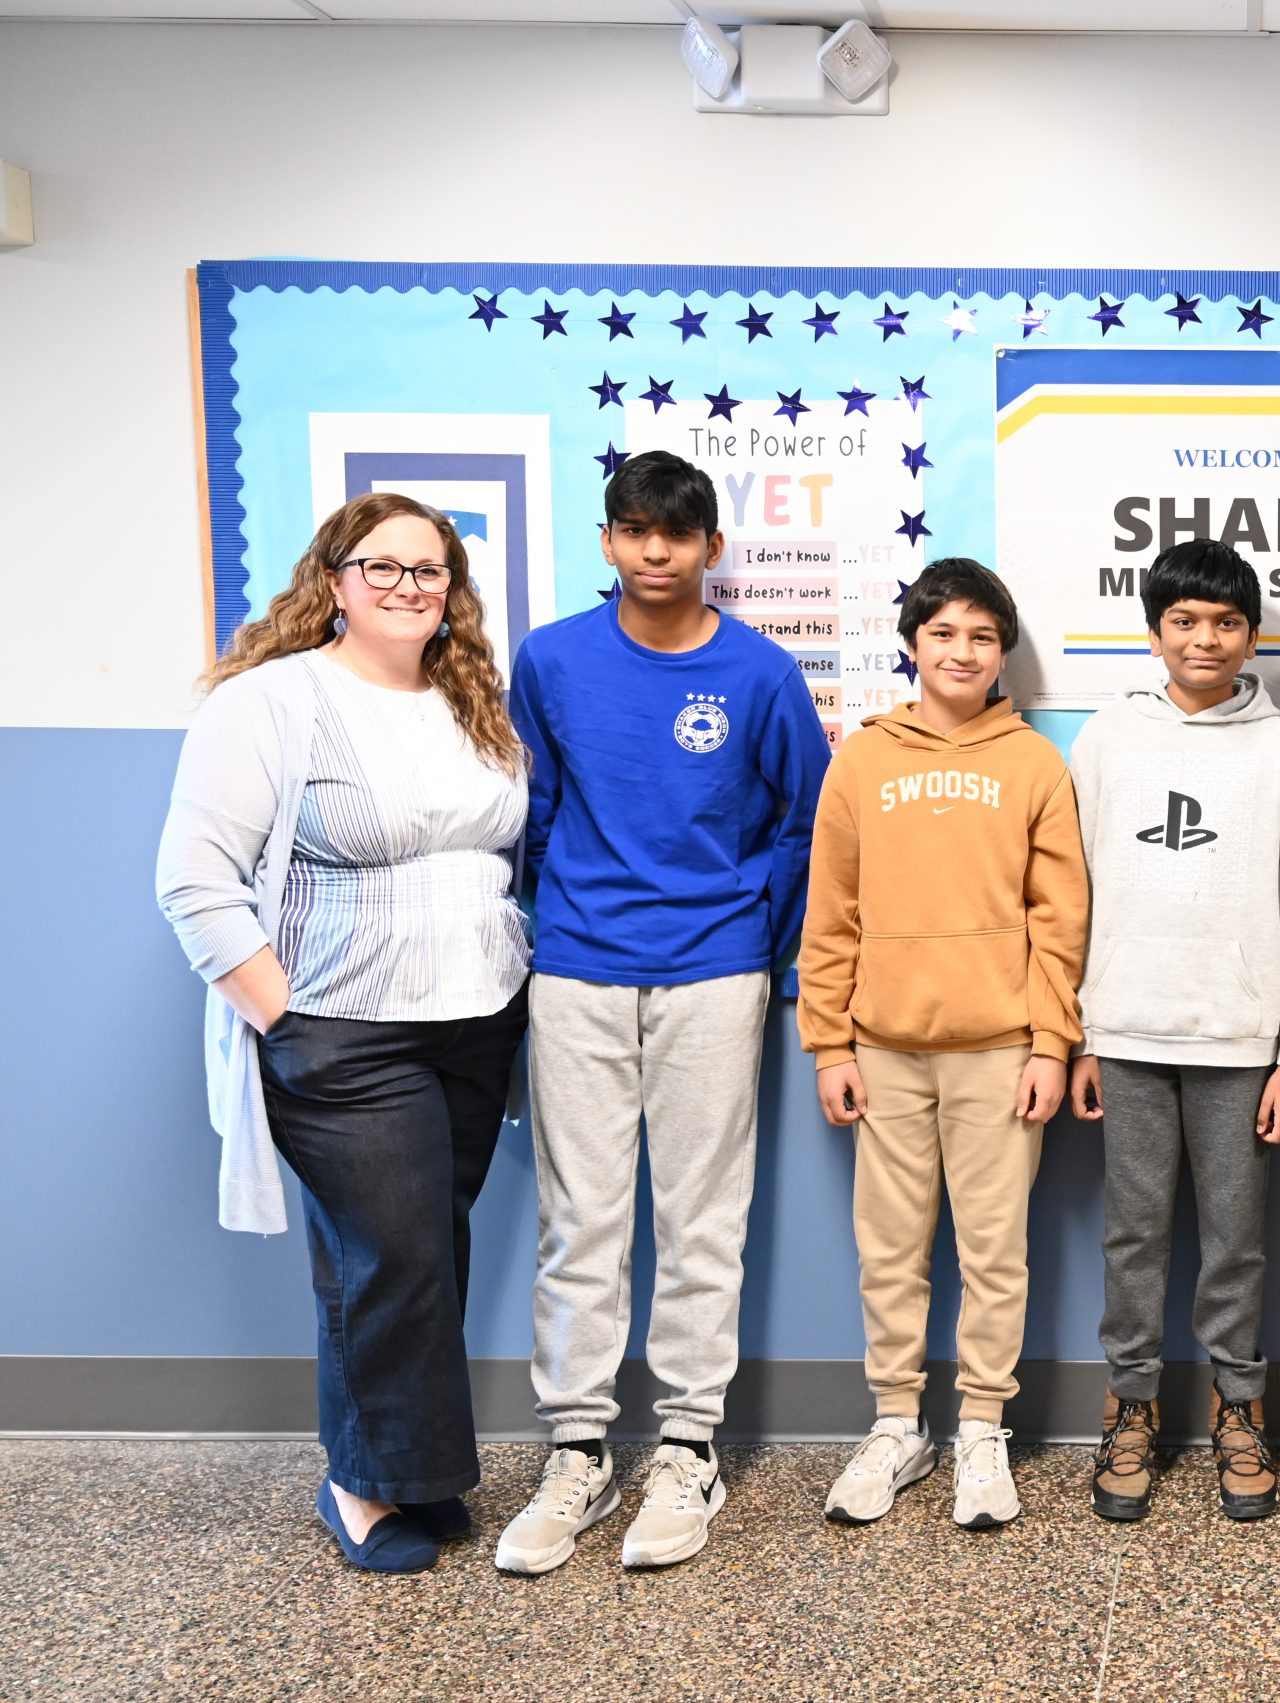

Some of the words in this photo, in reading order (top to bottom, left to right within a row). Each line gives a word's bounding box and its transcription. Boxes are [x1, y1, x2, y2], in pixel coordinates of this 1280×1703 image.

[689, 428, 736, 456] The
[750, 428, 826, 457] Power
[839, 428, 867, 456] of
[724, 471, 834, 527] YET
[746, 549, 752, 563] I
[757, 549, 792, 563] don't
[797, 548, 831, 563] know
[712, 585, 740, 599] This
[744, 585, 794, 599] doesn't
[799, 586, 832, 599] work
[806, 620, 833, 635] this
[797, 659, 834, 672] sense
[812, 692, 835, 707] his
[880, 770, 1001, 813] SWOOSH
